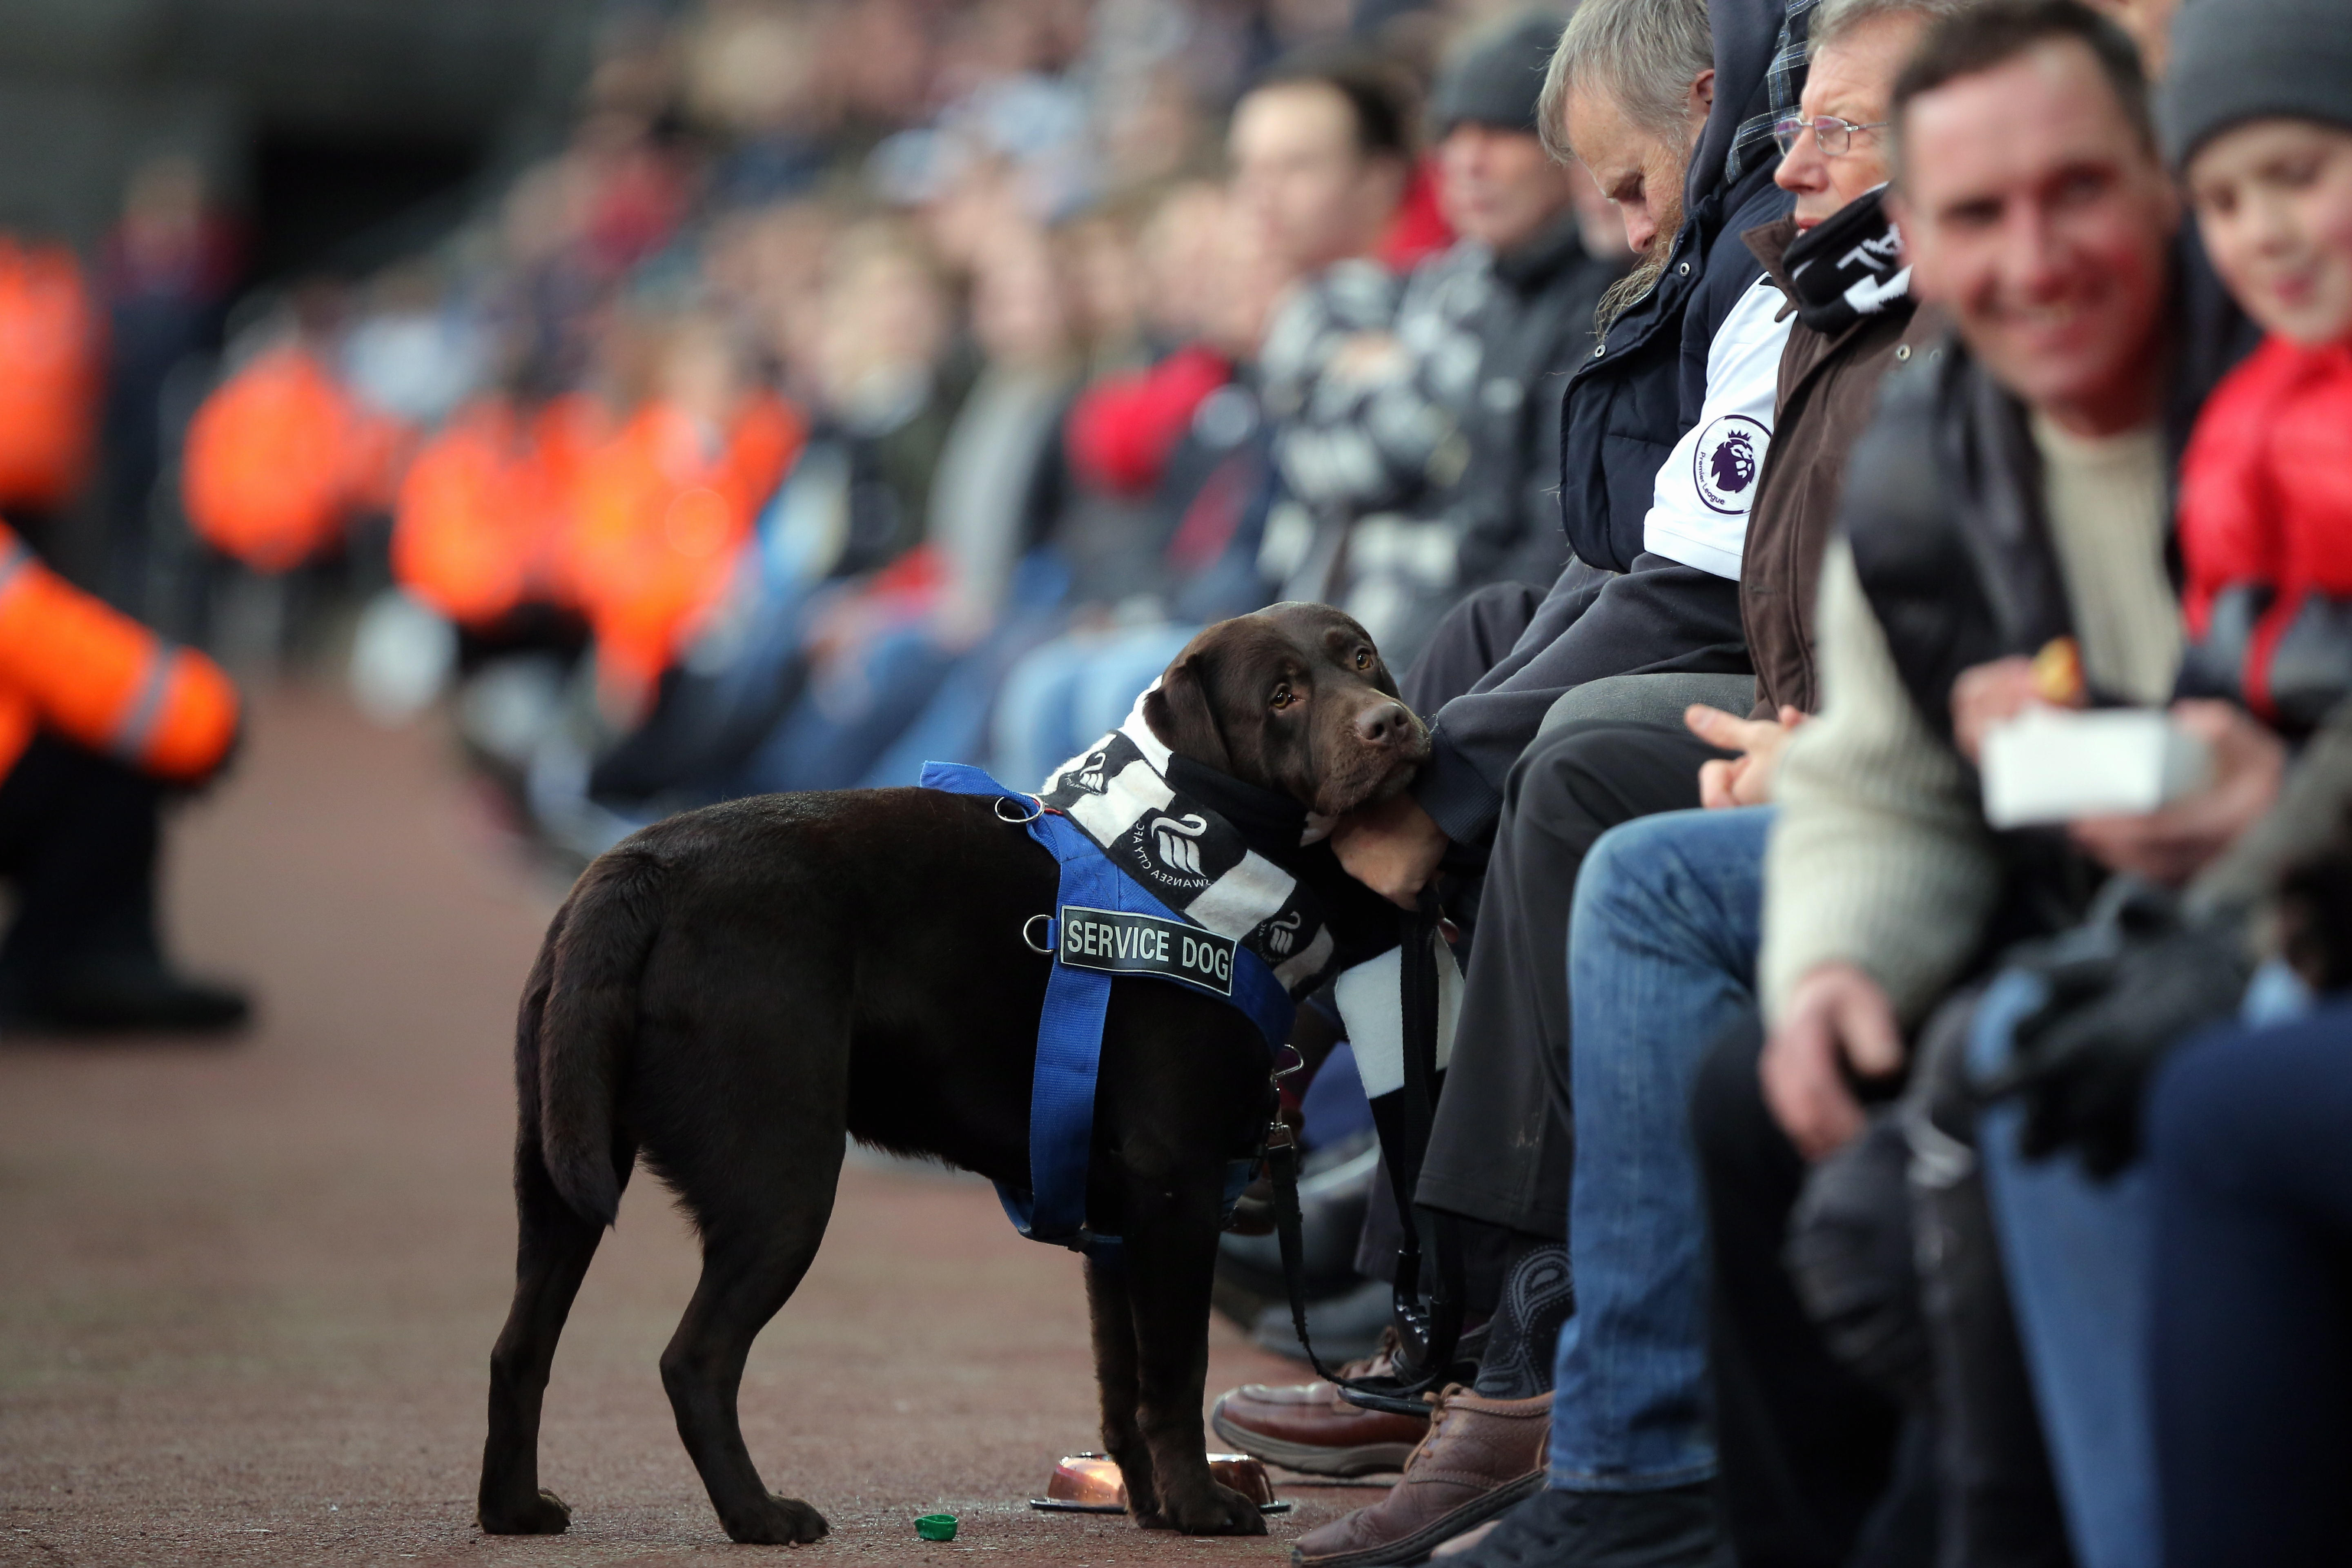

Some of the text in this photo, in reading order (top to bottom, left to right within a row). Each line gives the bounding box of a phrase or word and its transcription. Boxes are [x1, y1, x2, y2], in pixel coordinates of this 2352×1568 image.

[1702, 483, 1725, 505] League
[1067, 920, 1170, 962] SERVICE
[1182, 936, 1229, 981] DOG
